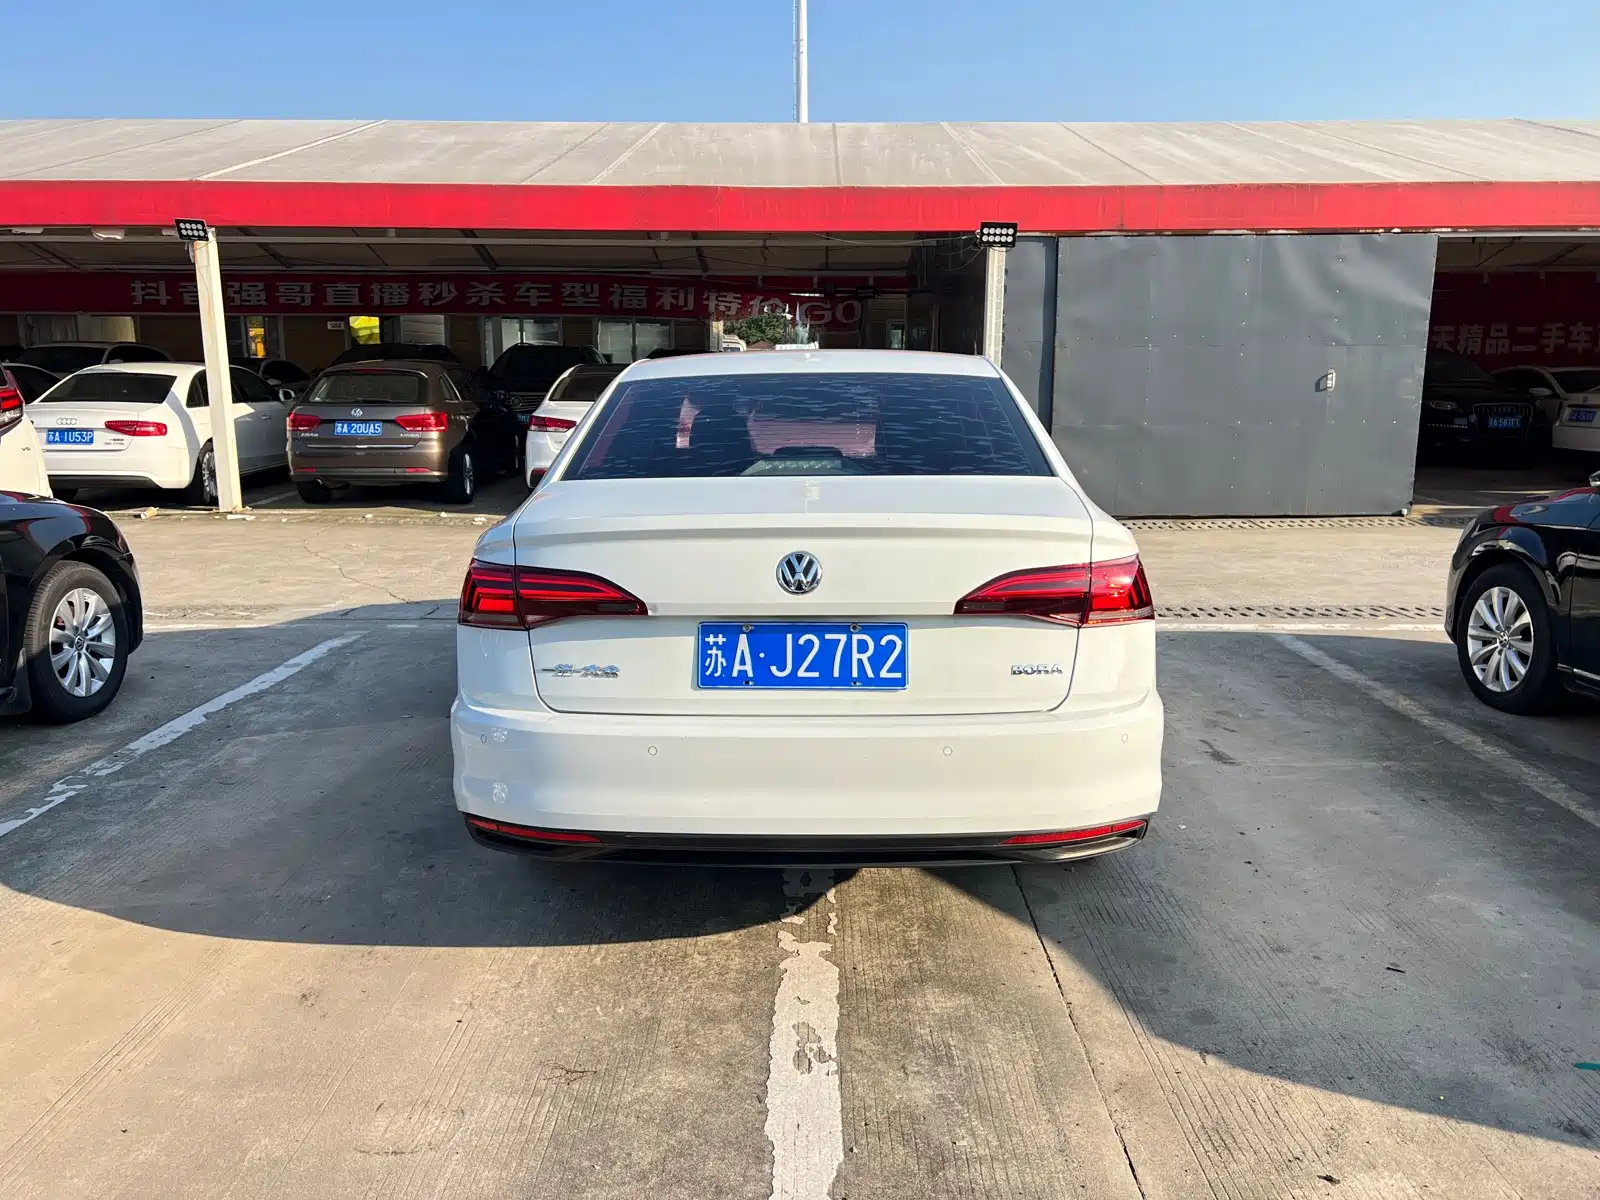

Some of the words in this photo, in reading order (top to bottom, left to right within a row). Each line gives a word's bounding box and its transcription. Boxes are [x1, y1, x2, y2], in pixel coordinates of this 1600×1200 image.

[1431, 322, 1600, 356] 天精品二手车
[704, 632, 904, 679] 苏A·J27R2
[1010, 663, 1063, 676] BORA
